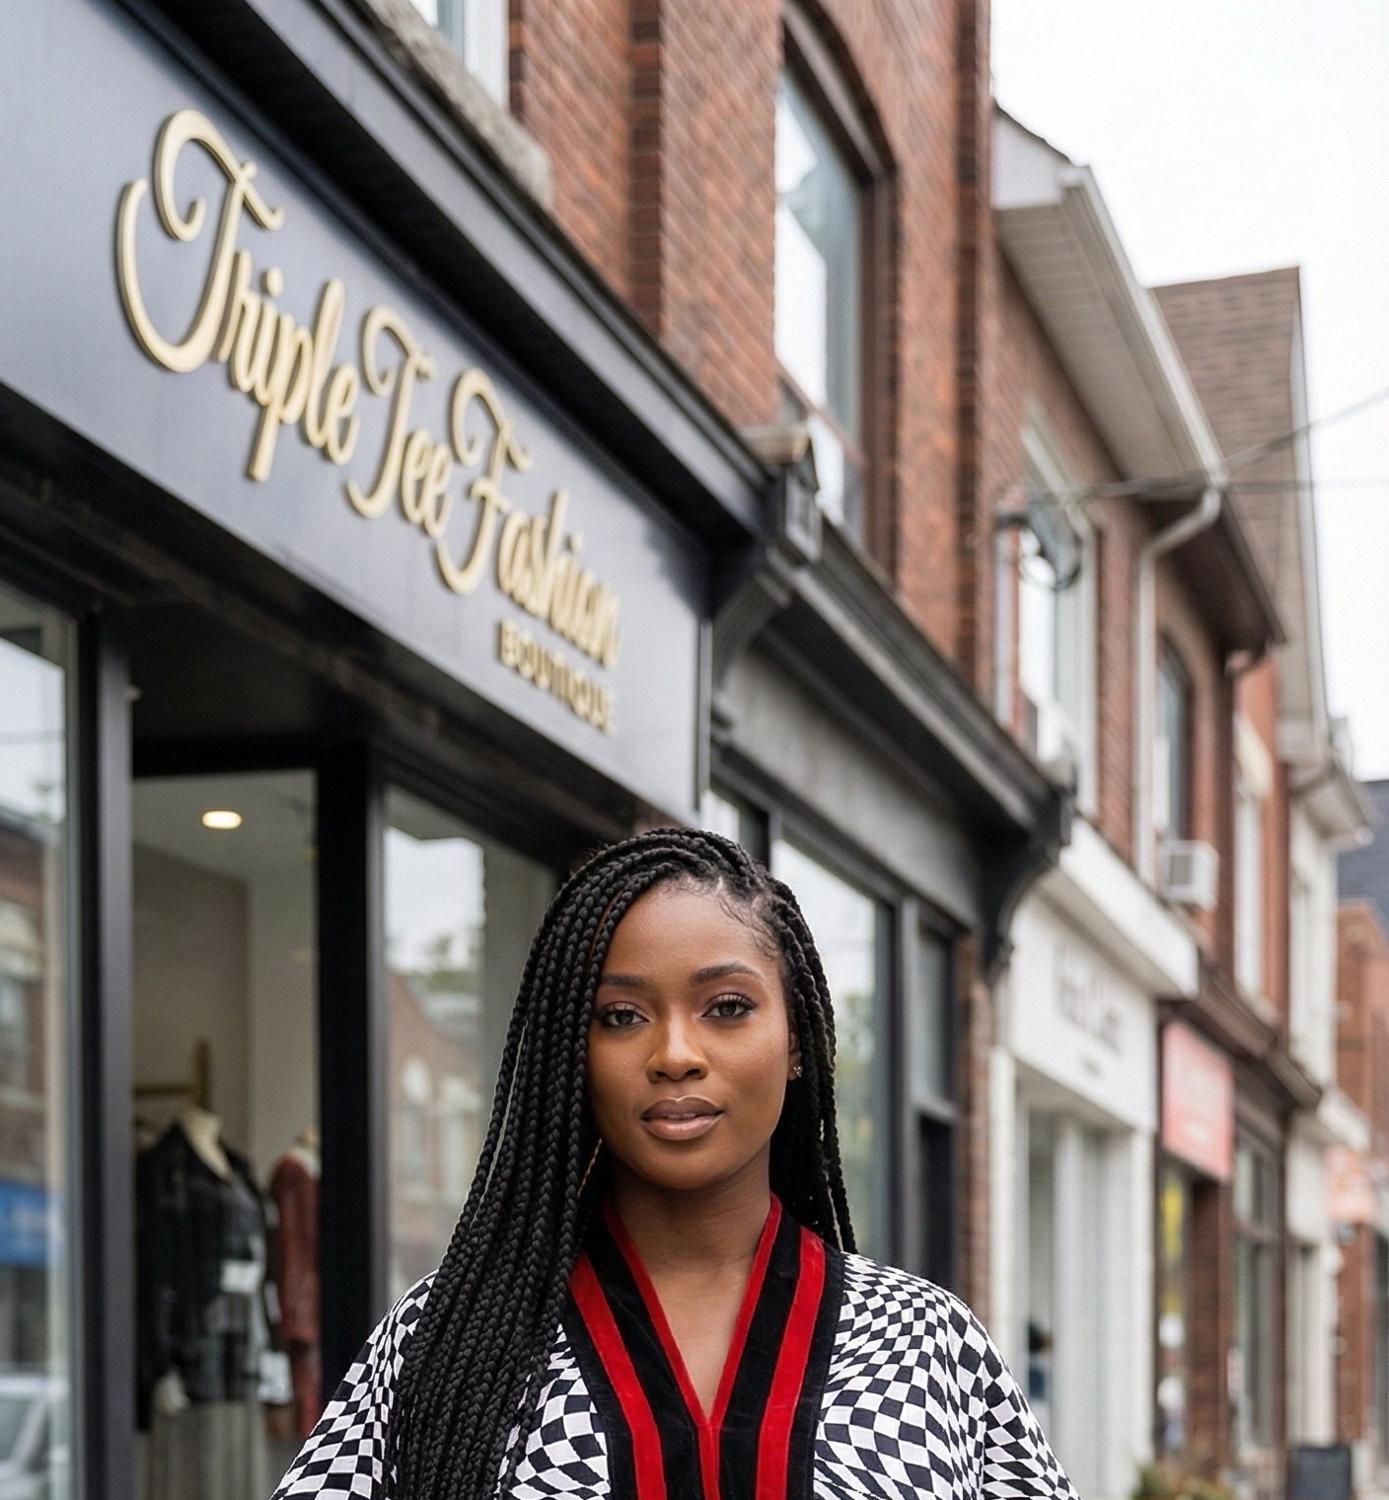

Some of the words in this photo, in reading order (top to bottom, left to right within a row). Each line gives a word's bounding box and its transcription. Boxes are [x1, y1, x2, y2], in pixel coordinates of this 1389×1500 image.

[116, 109, 359, 481] Triple
[349, 307, 452, 539] Tee
[437, 368, 619, 669] Fashion
[496, 617, 616, 735] BOUTIQUE
